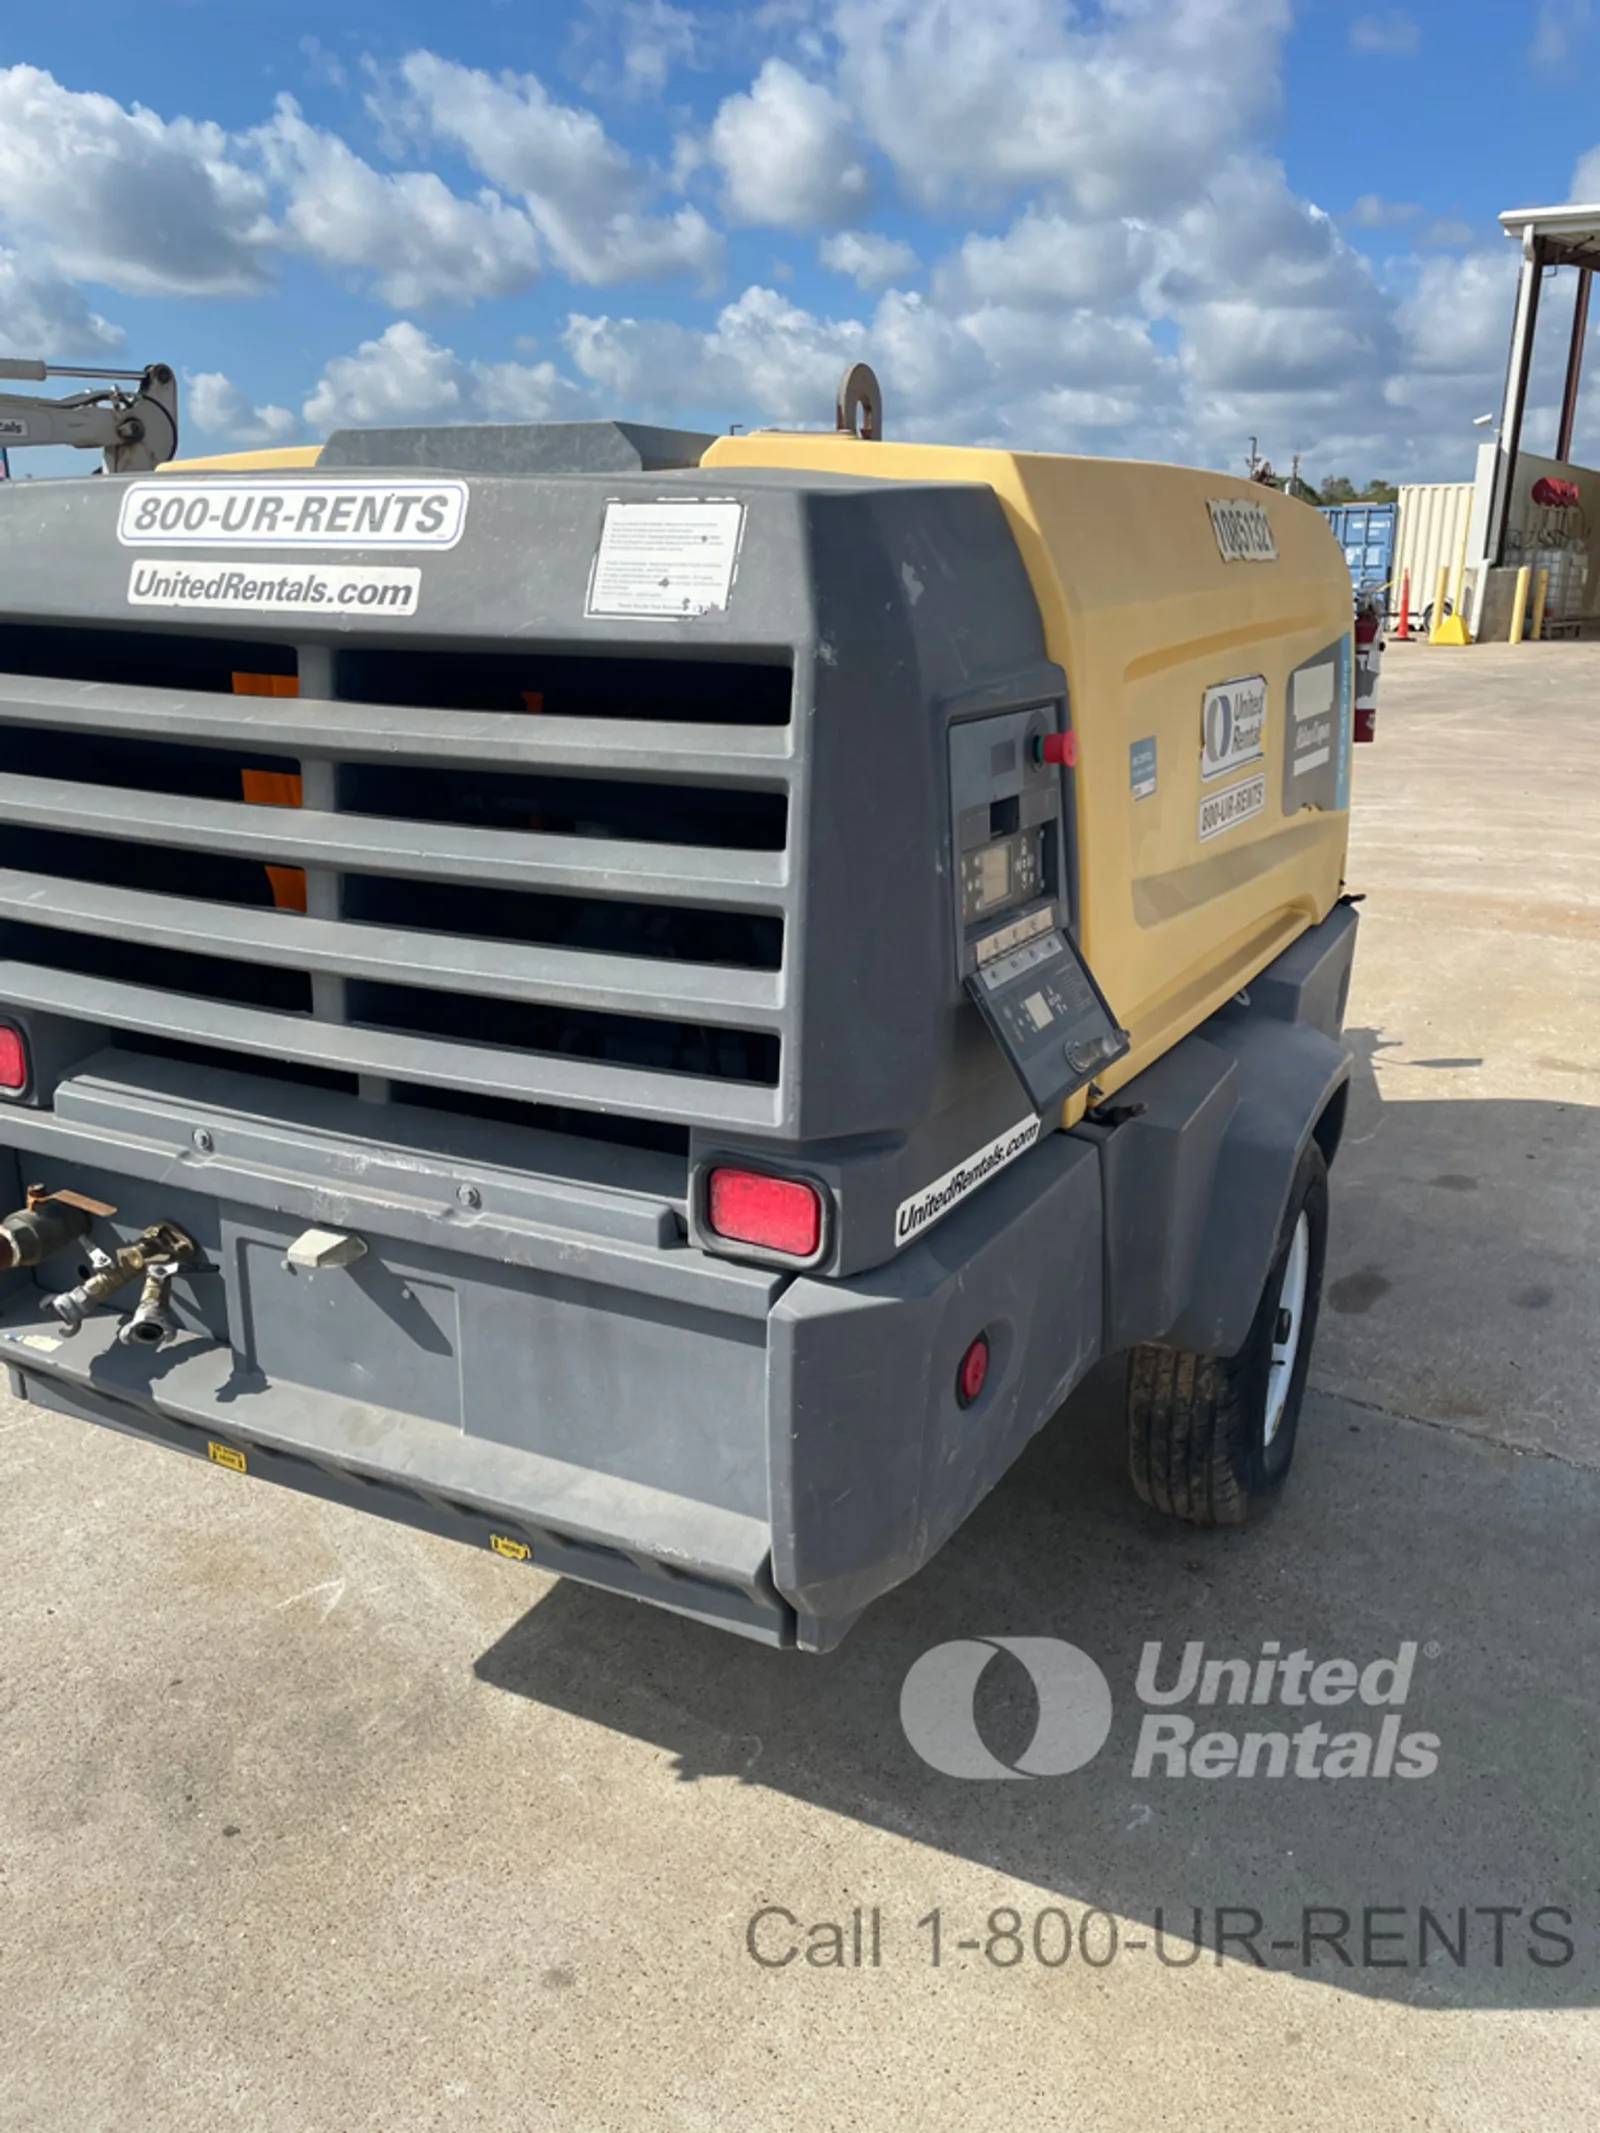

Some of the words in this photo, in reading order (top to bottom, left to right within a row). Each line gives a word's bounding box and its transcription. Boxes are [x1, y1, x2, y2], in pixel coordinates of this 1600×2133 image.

[134, 495, 449, 534] 800-UR-RENTS
[133, 569, 413, 606] UnitedRentals.com
[1234, 687, 1265, 721] United
[1201, 782, 1264, 832] 800-UR-RENTS
[898, 1122, 1038, 1236] UnitedRentals.com
